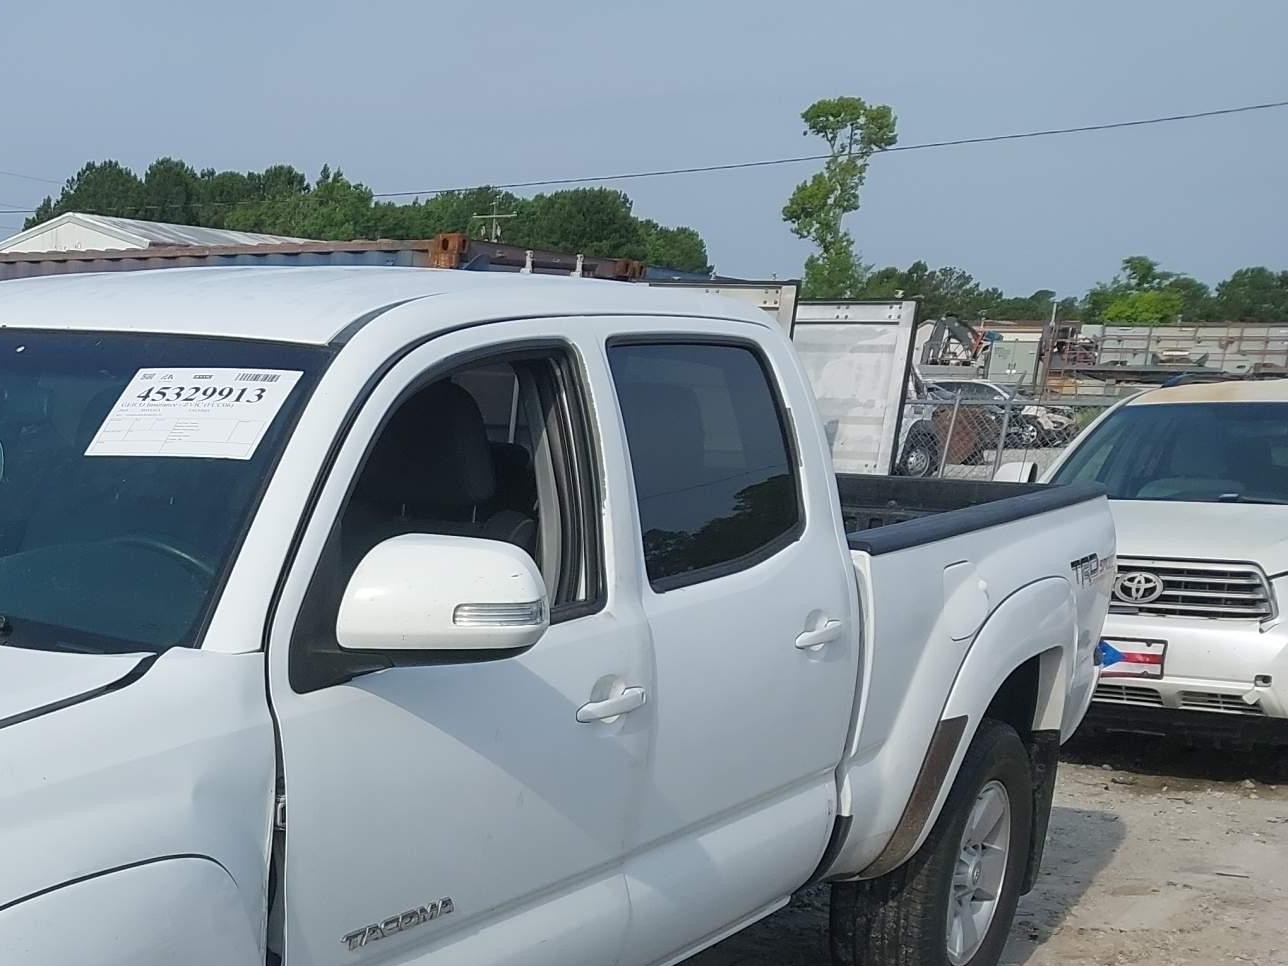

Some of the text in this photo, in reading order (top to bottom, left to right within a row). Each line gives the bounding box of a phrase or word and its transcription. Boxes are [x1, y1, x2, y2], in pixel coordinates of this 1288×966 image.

[137, 386, 267, 403] 45329913
[1070, 552, 1099, 586] TRD
[339, 896, 455, 951] TACOMA
